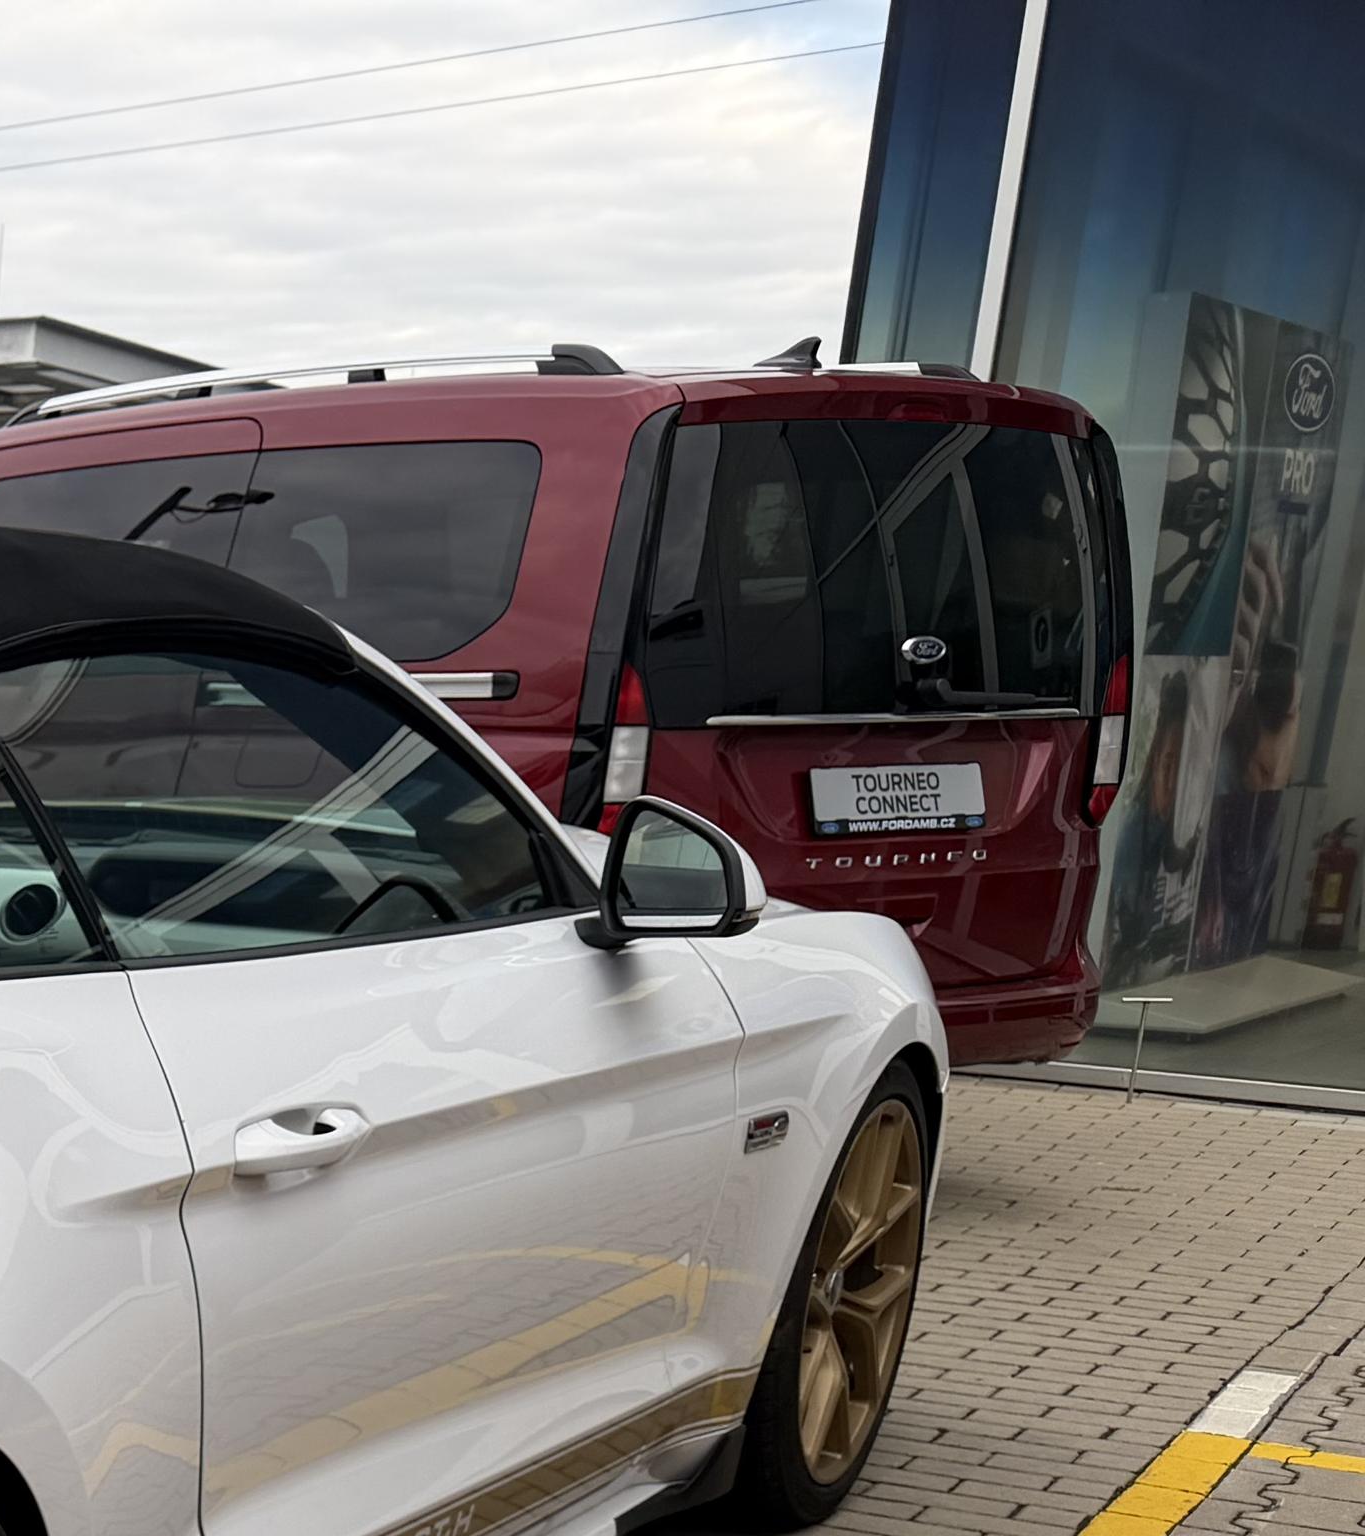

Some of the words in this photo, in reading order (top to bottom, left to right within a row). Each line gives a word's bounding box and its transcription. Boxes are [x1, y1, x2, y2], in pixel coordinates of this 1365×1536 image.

[1279, 448, 1315, 496] PRO
[851, 771, 941, 793] TOURNEO
[855, 793, 942, 815] CONNECT
[847, 817, 957, 834] WWW.FORDAMB.CZ
